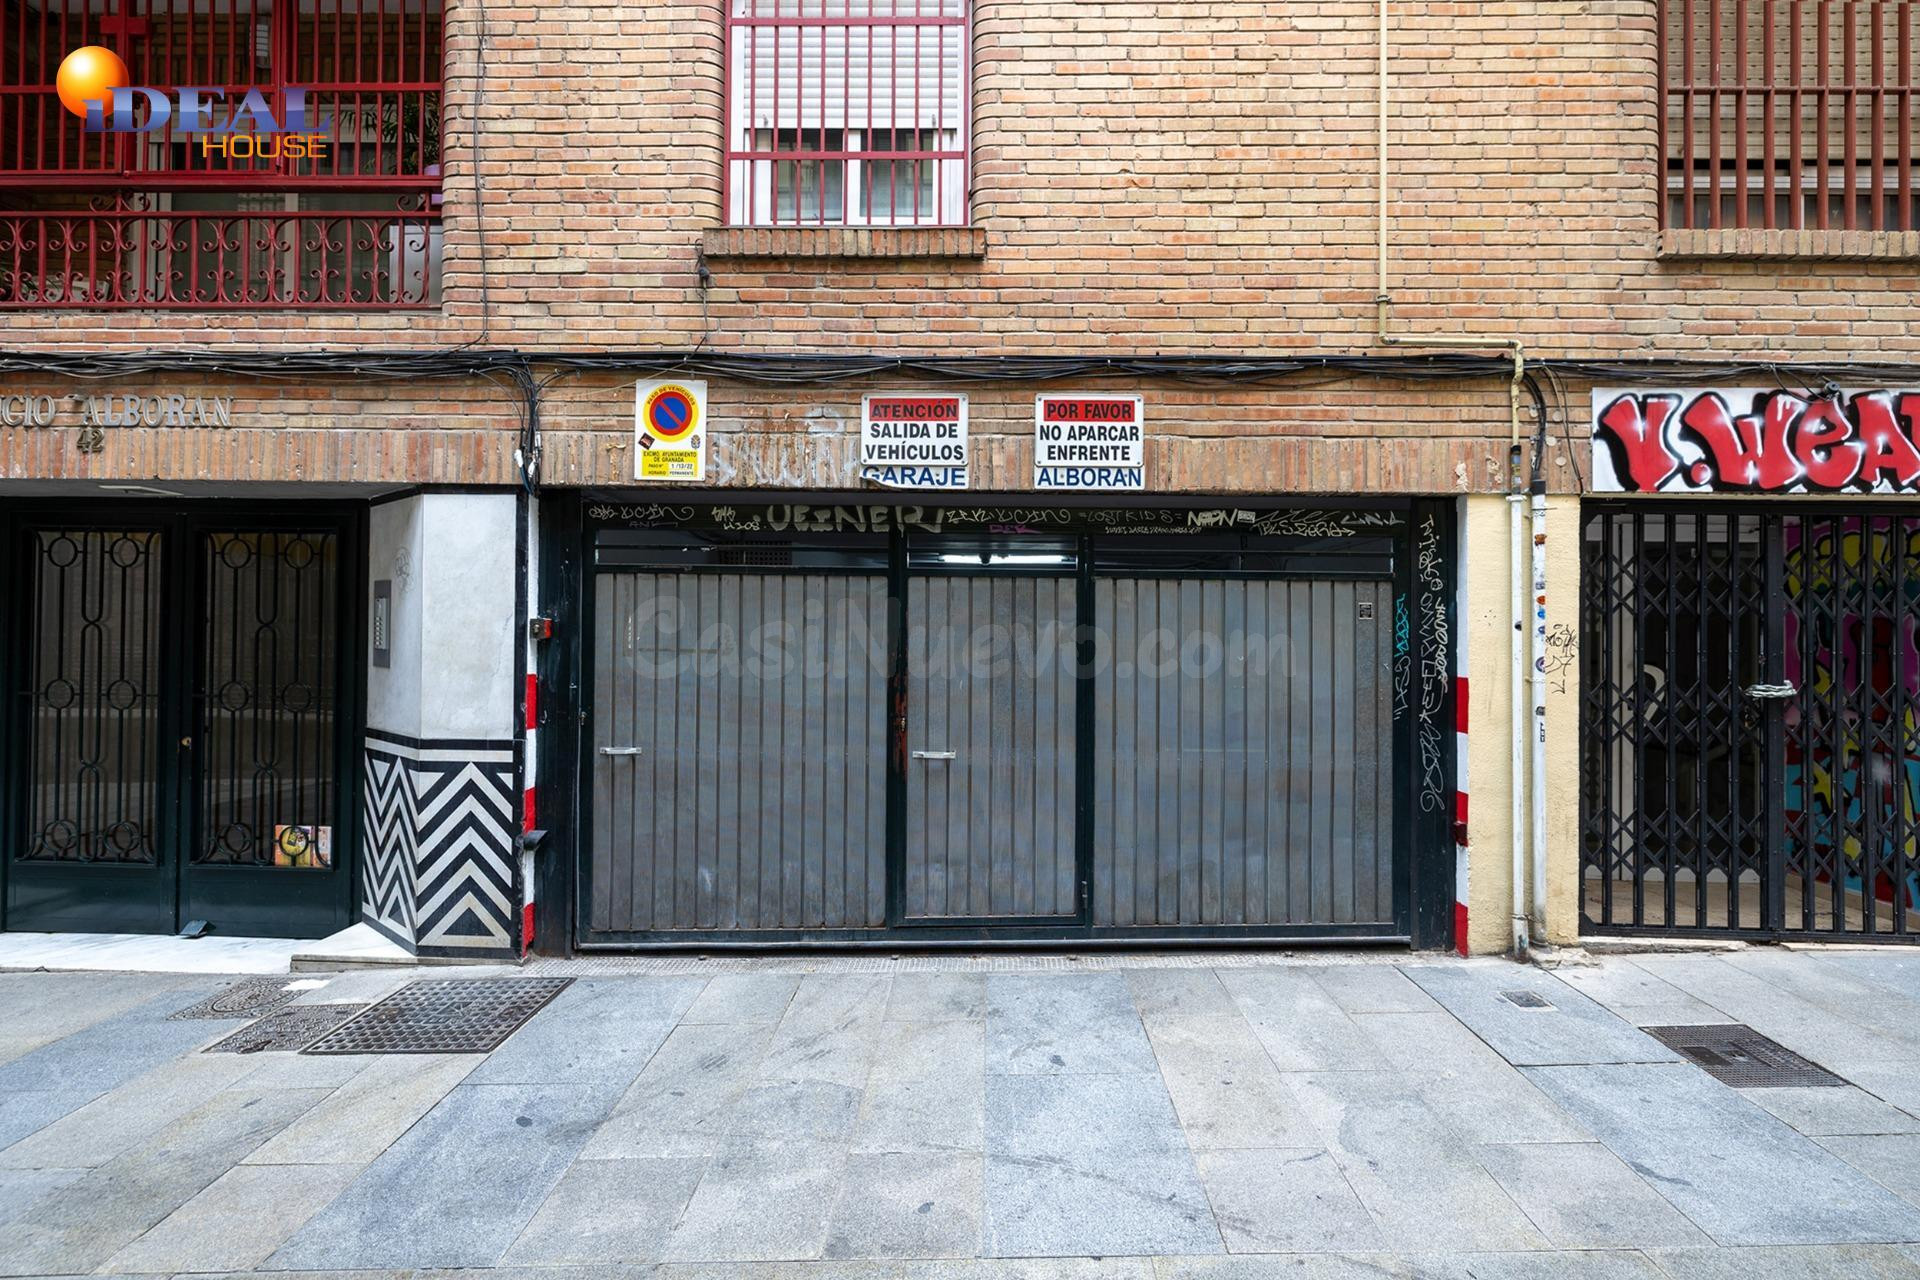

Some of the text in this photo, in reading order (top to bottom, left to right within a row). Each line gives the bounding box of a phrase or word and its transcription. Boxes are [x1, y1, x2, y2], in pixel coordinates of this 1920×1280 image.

[0, 393, 233, 428] CIO ALBORAN
[872, 401, 957, 418] ATENCIÓN
[1047, 403, 1132, 419] POR FAVOR
[870, 422, 958, 439] SALIDA DE
[1040, 424, 1139, 442] NO APARCAR
[76, 429, 105, 453] 42
[865, 440, 964, 461] VEHÍCULOS
[1047, 444, 1130, 461] ENFRENTE
[862, 466, 966, 487] GARAJE
[1037, 467, 1142, 487] ALBORAN
